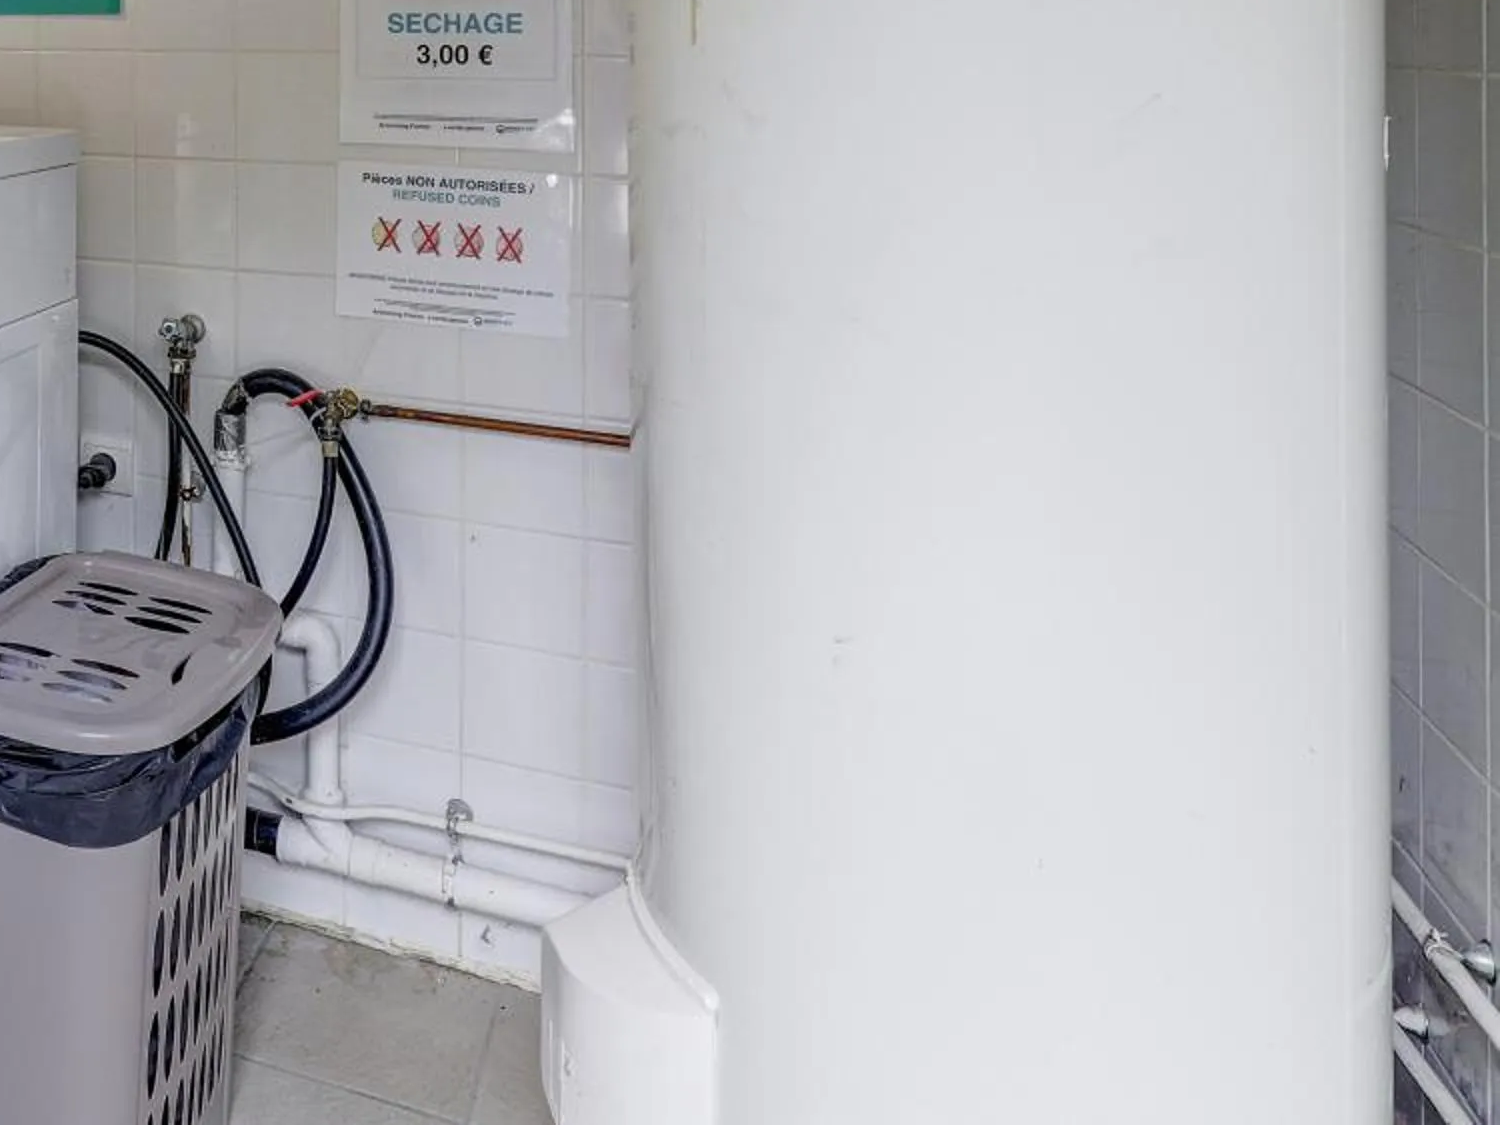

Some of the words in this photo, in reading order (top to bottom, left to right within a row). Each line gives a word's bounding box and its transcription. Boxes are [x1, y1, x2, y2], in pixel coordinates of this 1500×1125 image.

[387, 12, 523, 34] SECHAGE
[416, 44, 469, 68] 3,00
[478, 44, 493, 65] €
[362, 172, 403, 186] Pièces
[405, 175, 436, 189] NON
[439, 177, 527, 194] AUTORISÉES
[392, 190, 455, 205] REFUSED
[458, 193, 502, 208] COINS
